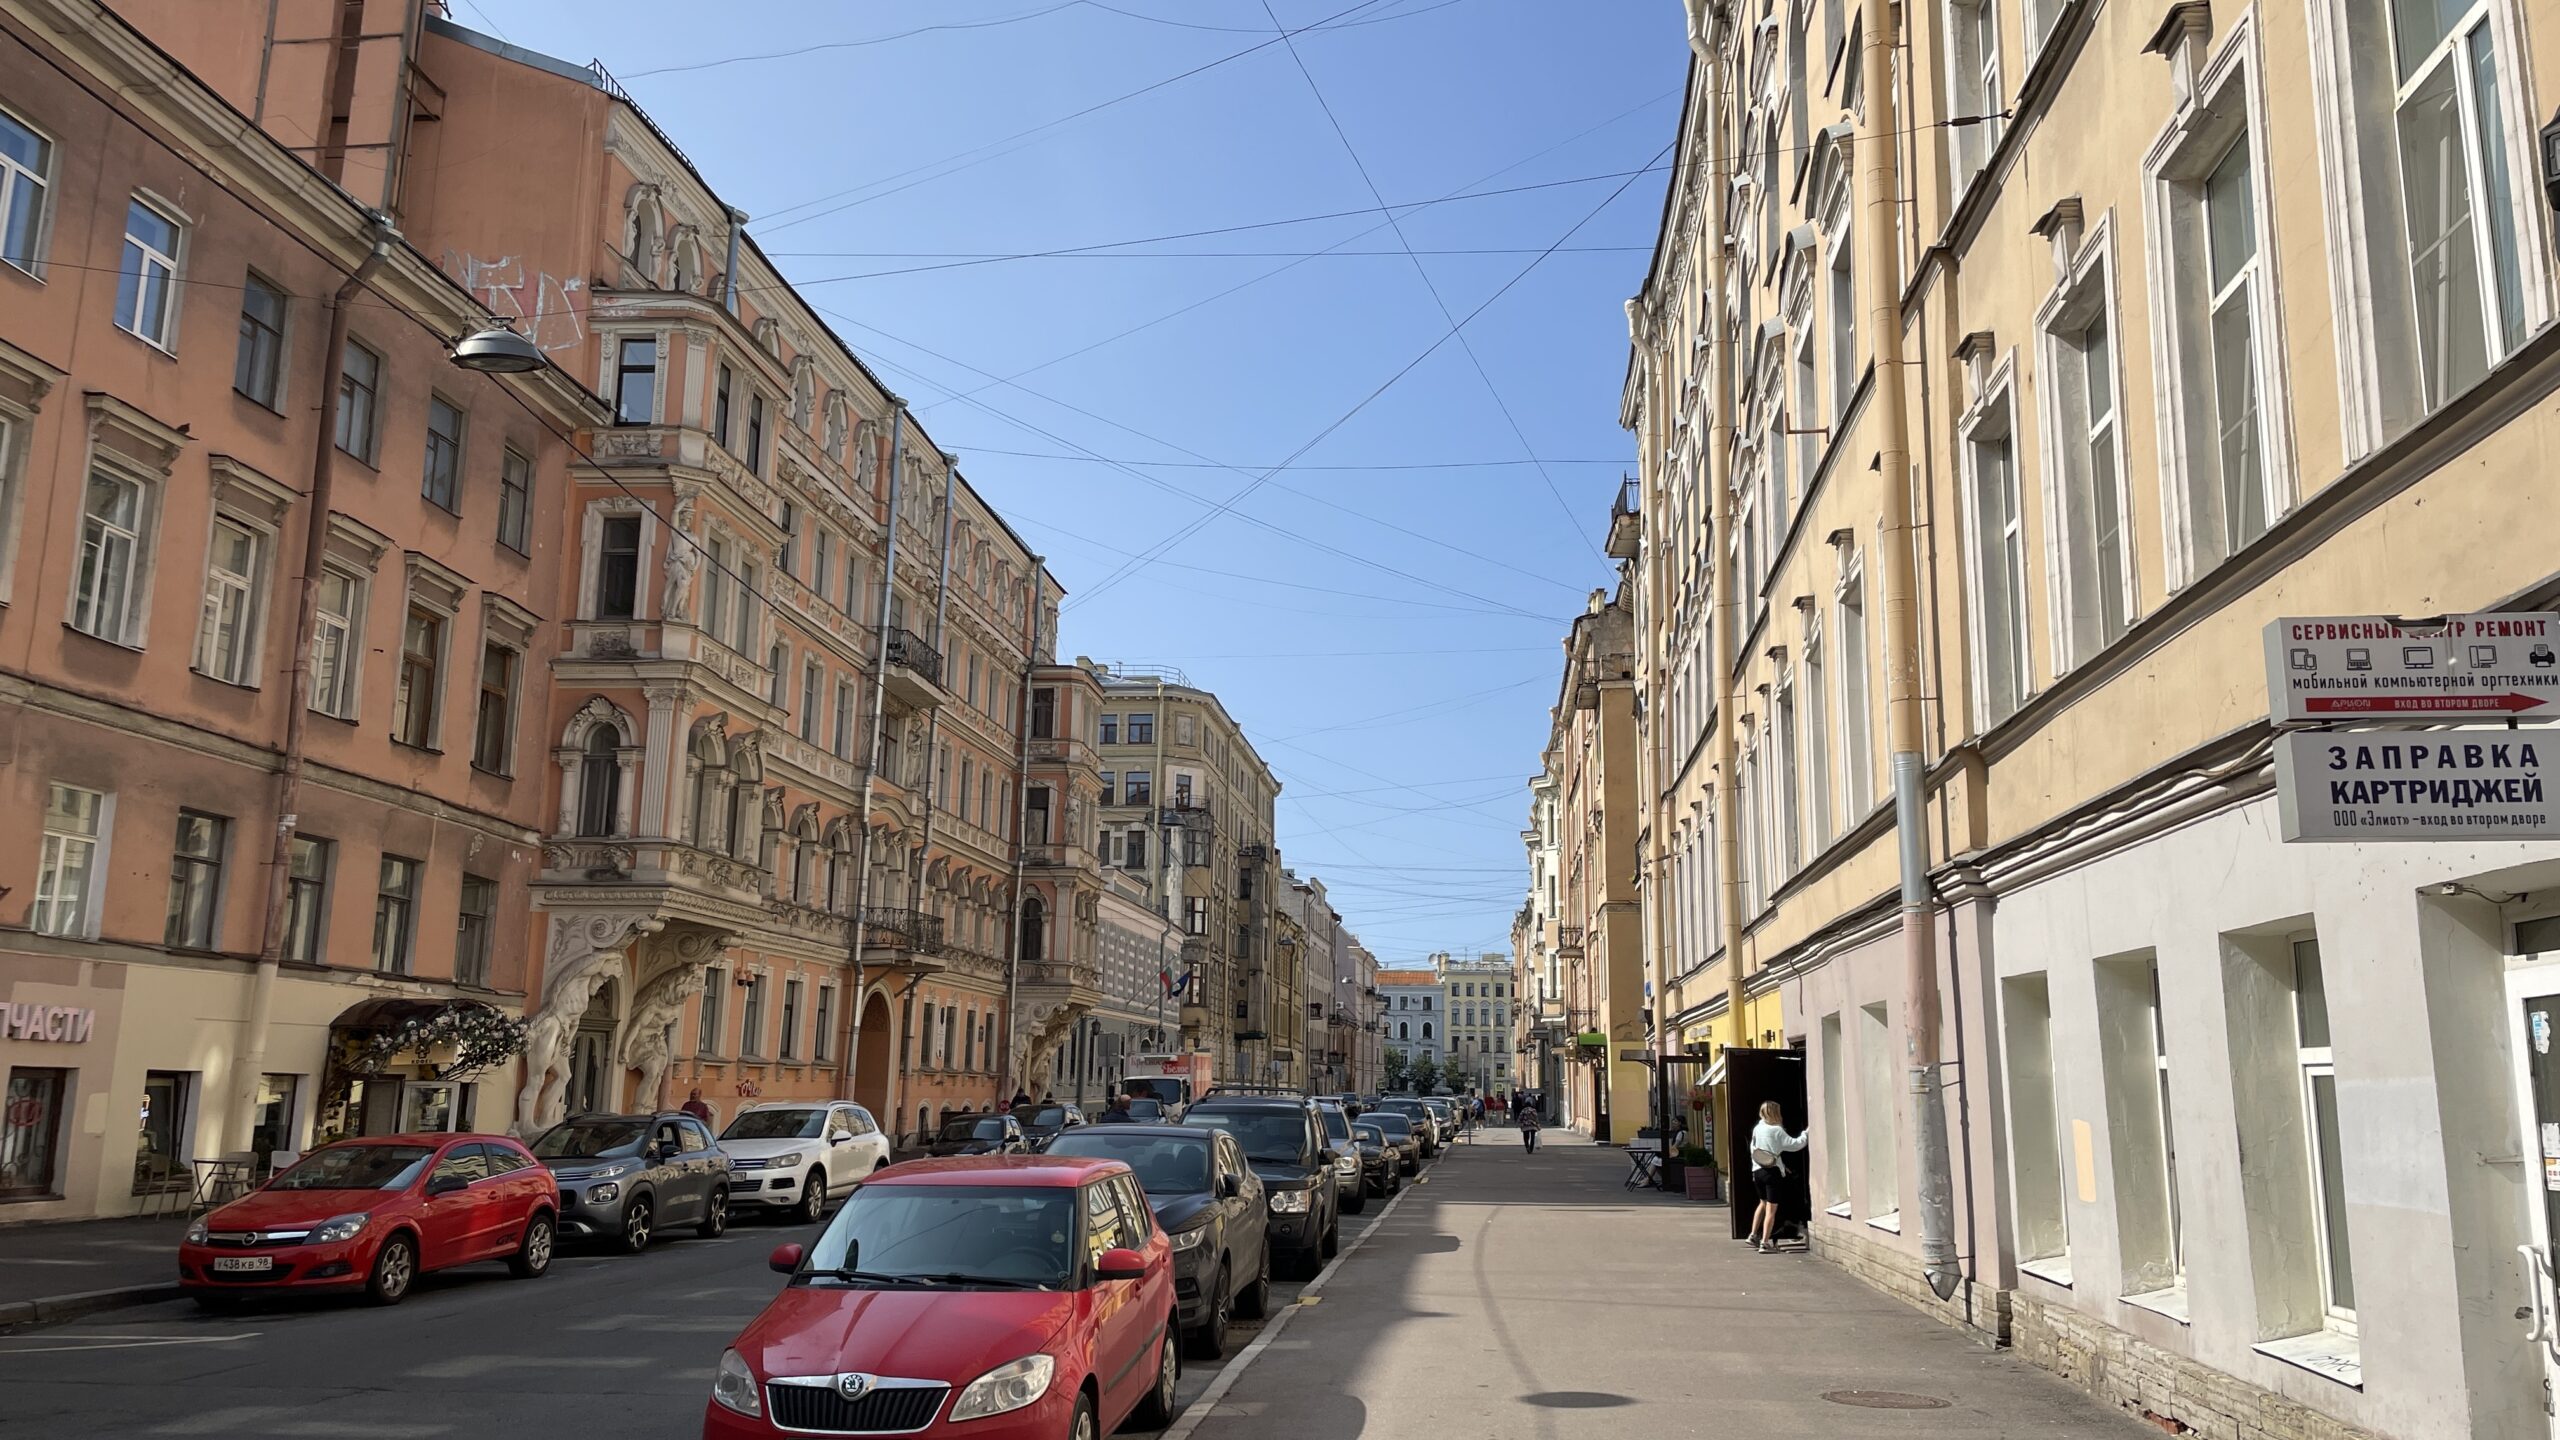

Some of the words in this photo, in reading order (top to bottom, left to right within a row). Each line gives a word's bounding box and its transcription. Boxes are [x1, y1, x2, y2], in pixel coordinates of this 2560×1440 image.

[2475, 620, 2546, 637] РЕМОНТ
[2293, 671, 2368, 689] мобильной
[2374, 671, 2475, 691] компьютерной
[2481, 674, 2559, 691] оргтехники
[2395, 699, 2418, 709] ВХОД
[2421, 699, 2432, 708] ВО
[2434, 698, 2468, 708] ВТОРОМ
[2472, 698, 2499, 708] ДВОРЕ
[2328, 743, 2540, 770] ЗАПРАВКА
[2330, 772, 2544, 808] КАРТРИДЖЕЙ
[2333, 810, 2357, 827] ООО
[2450, 815, 2464, 826] во
[2466, 814, 2508, 829] втором
[2511, 814, 2546, 829] дворе
